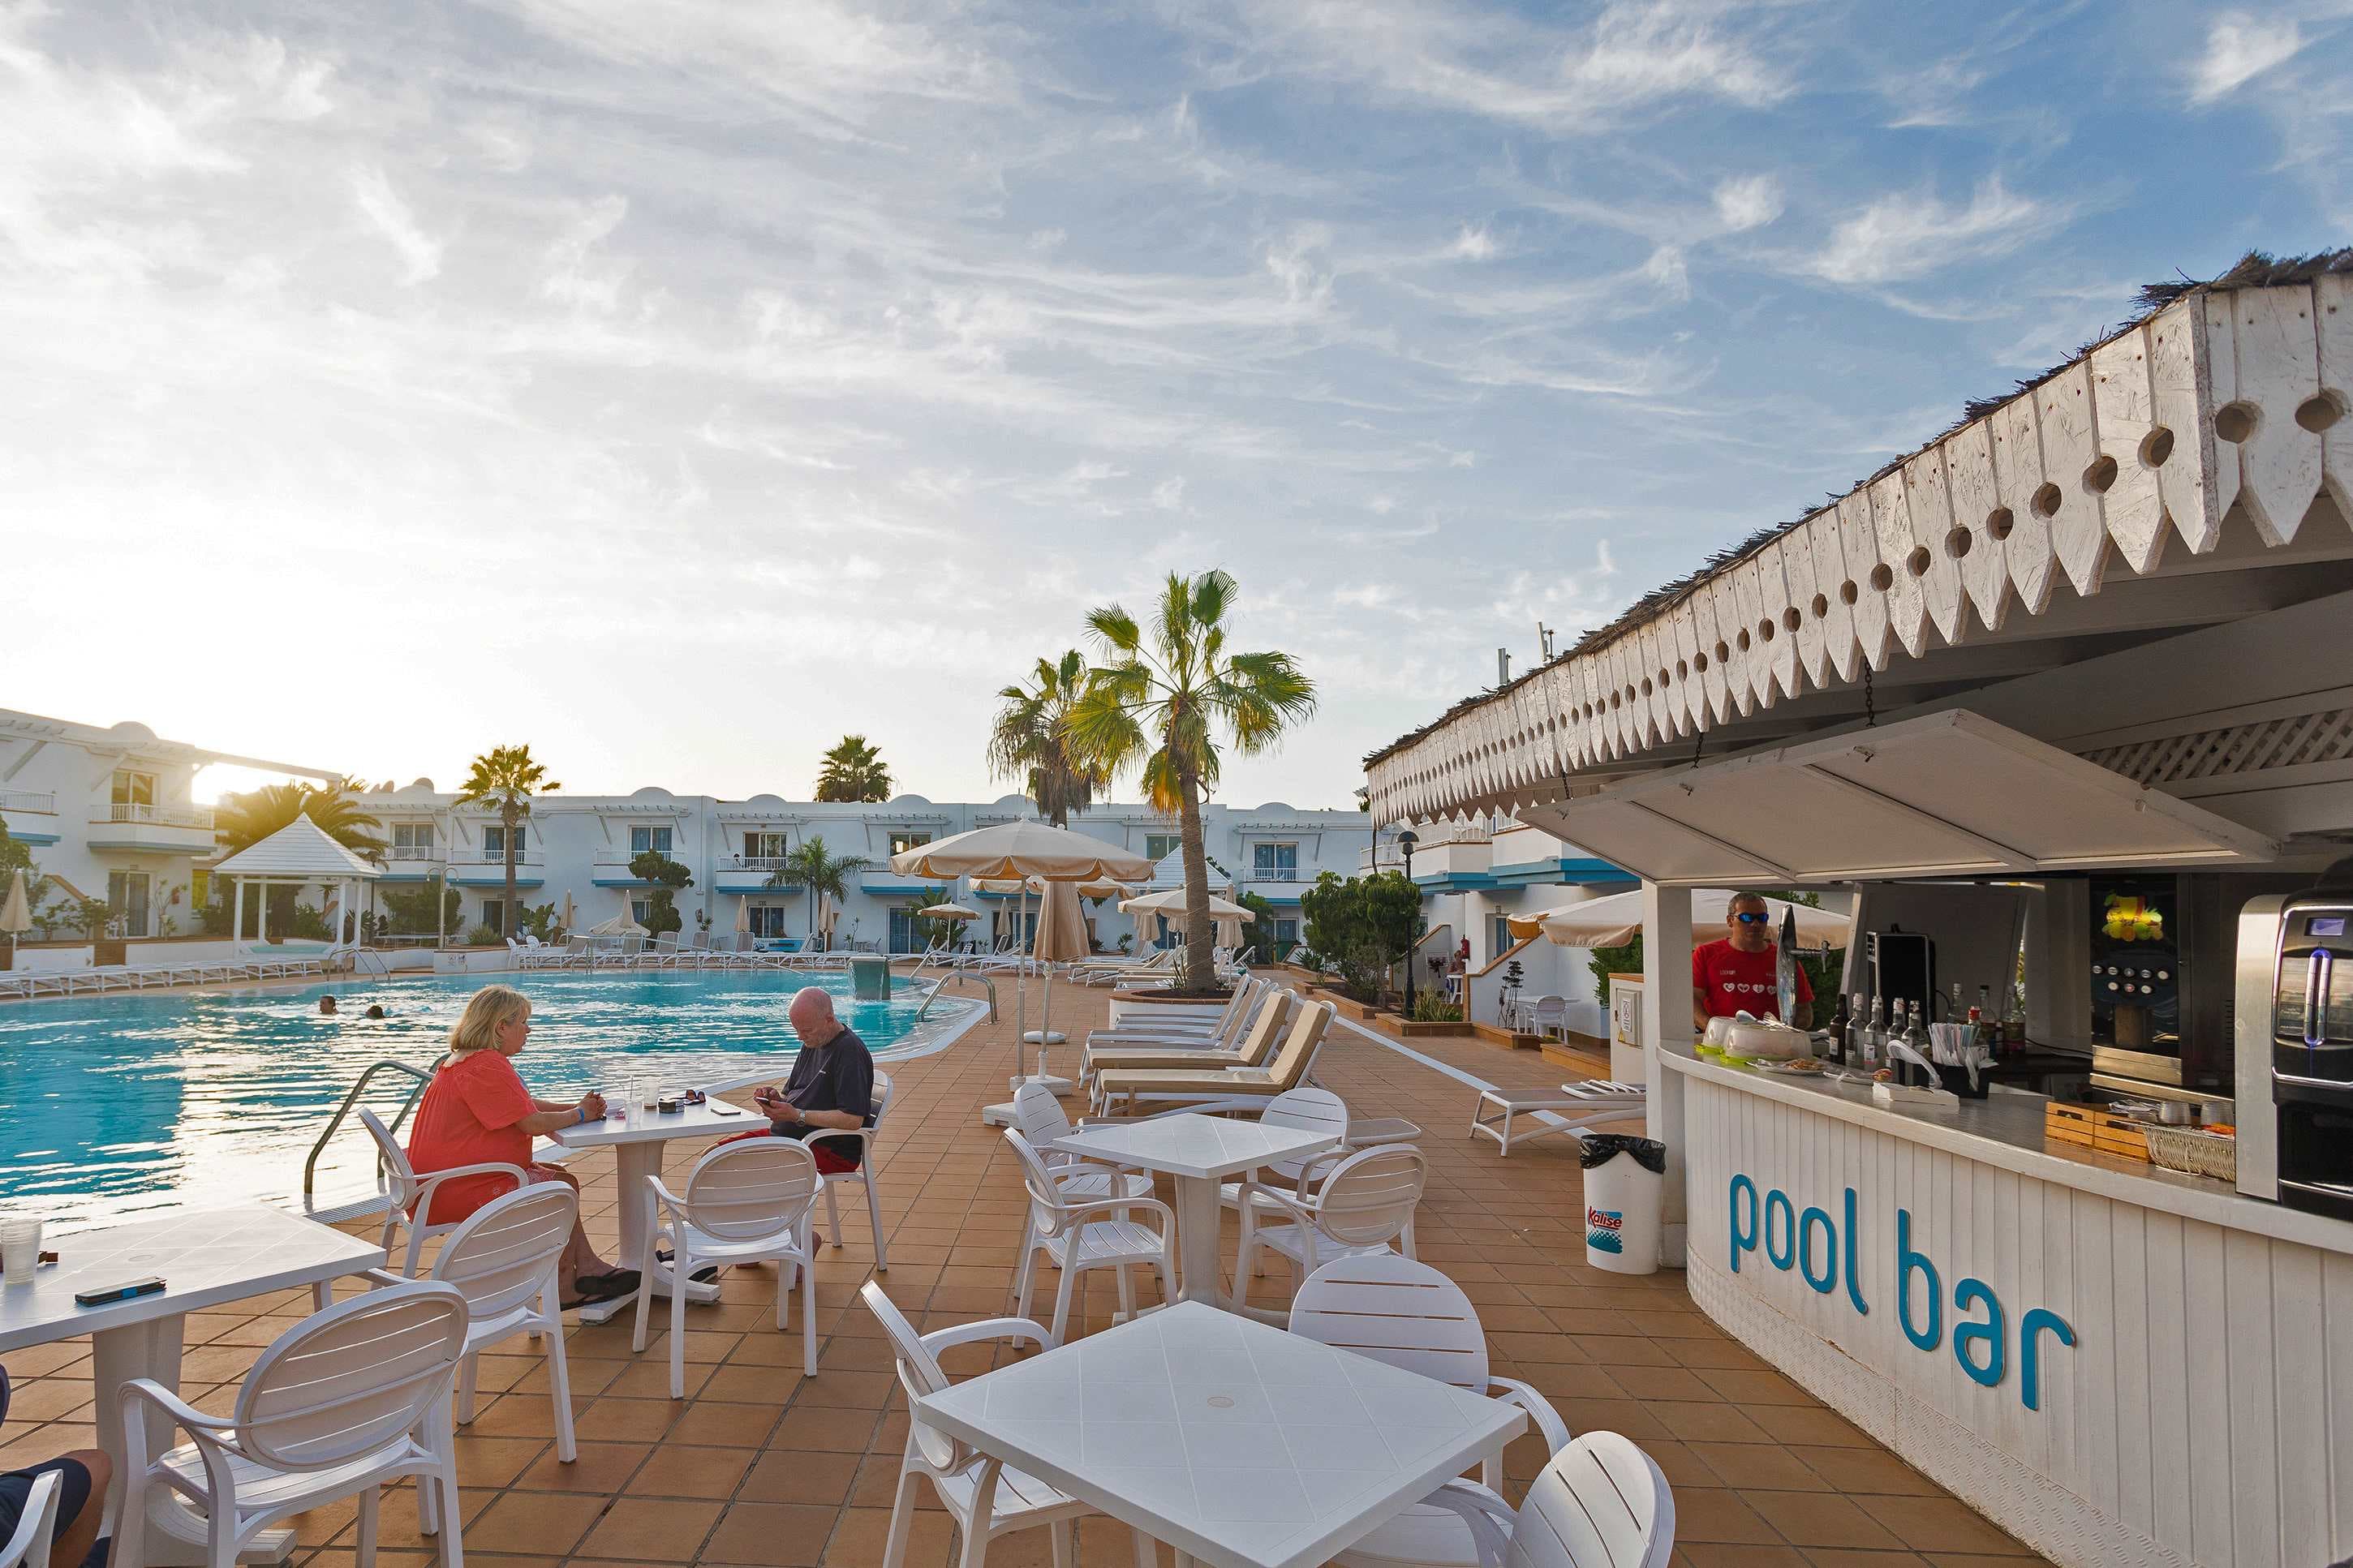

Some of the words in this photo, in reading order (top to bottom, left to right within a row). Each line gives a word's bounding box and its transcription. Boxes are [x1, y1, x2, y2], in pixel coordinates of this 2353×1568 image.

[1588, 1205, 1622, 1228] Kalise
[1729, 1174, 1869, 1316] pool
[1897, 1208, 2076, 1411] bar
